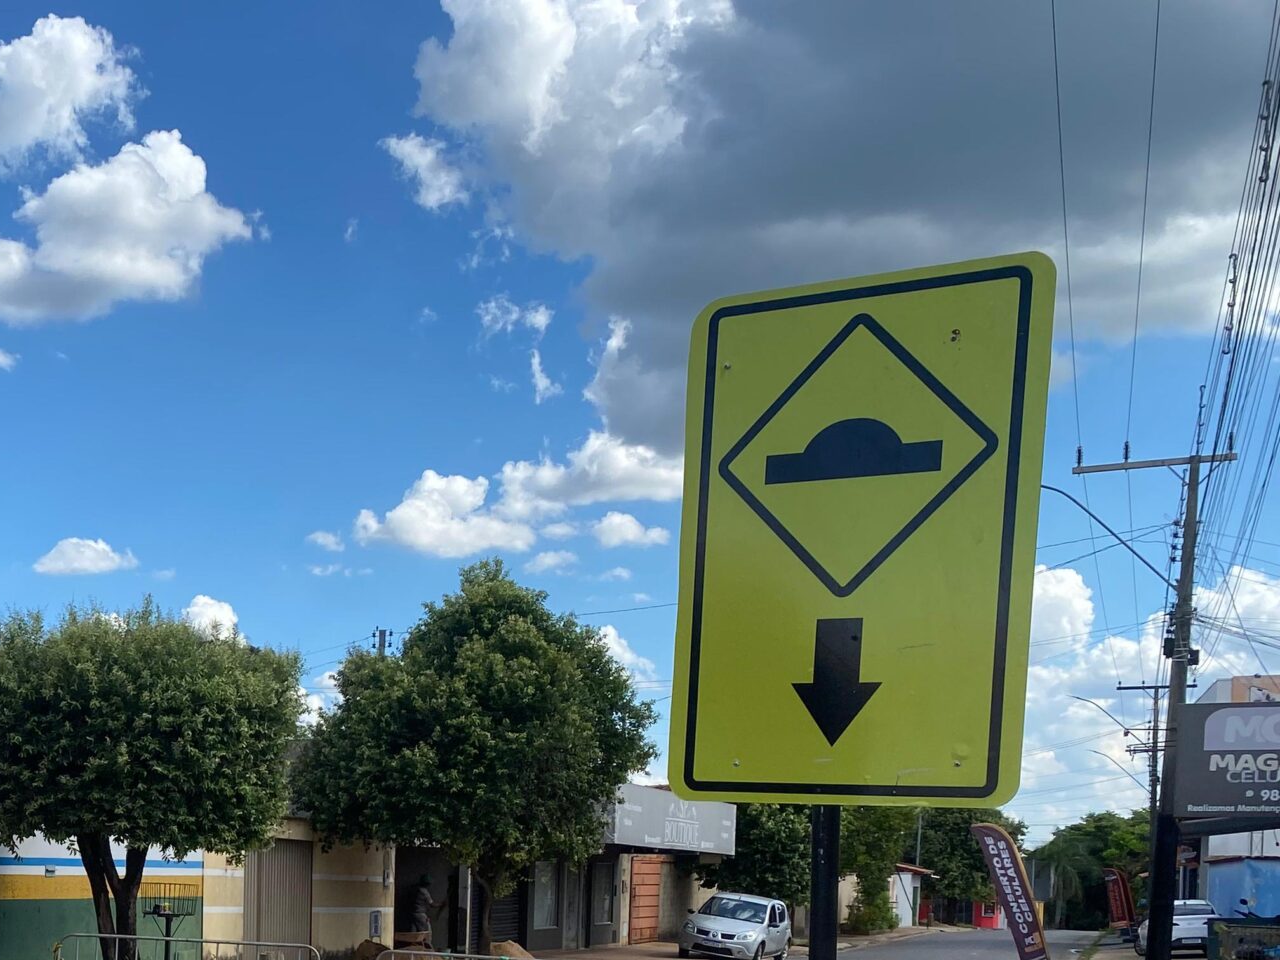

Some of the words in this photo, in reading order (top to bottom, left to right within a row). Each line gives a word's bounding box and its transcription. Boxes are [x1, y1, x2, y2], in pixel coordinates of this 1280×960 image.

[1209, 752, 1280, 772] MAG
[1260, 789, 1280, 801] 98
[664, 821, 699, 848] BOUTIQUE
[984, 836, 998, 855] DE
[997, 840, 1033, 922] CELULARES
[992, 857, 1029, 934] CONSERTO
